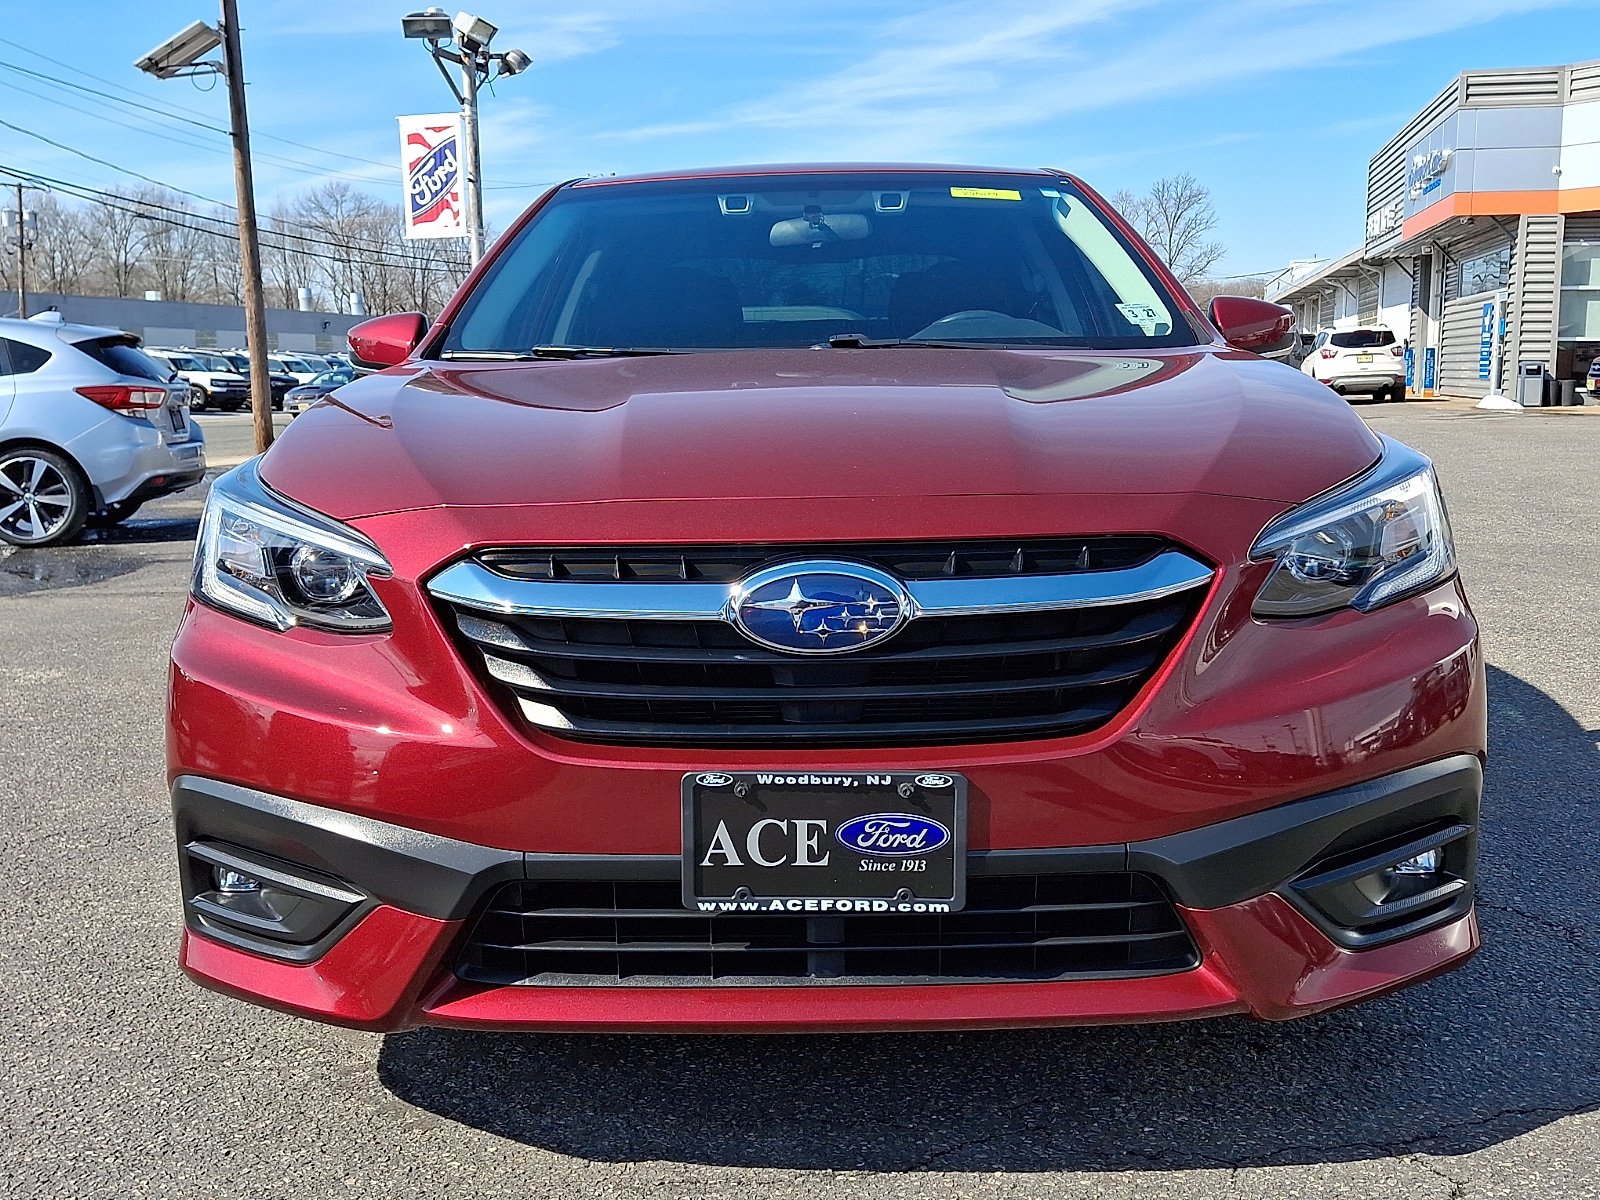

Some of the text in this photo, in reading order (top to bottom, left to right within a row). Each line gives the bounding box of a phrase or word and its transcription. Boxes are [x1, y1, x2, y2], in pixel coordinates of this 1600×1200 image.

[411, 148, 457, 205] Ford
[756, 774, 892, 787] Woodbury, NJ
[699, 818, 830, 867] ACE
[856, 819, 927, 849] Ford
[858, 859, 927, 872] Since 1913
[697, 899, 950, 913] www.ACEFORD.com
